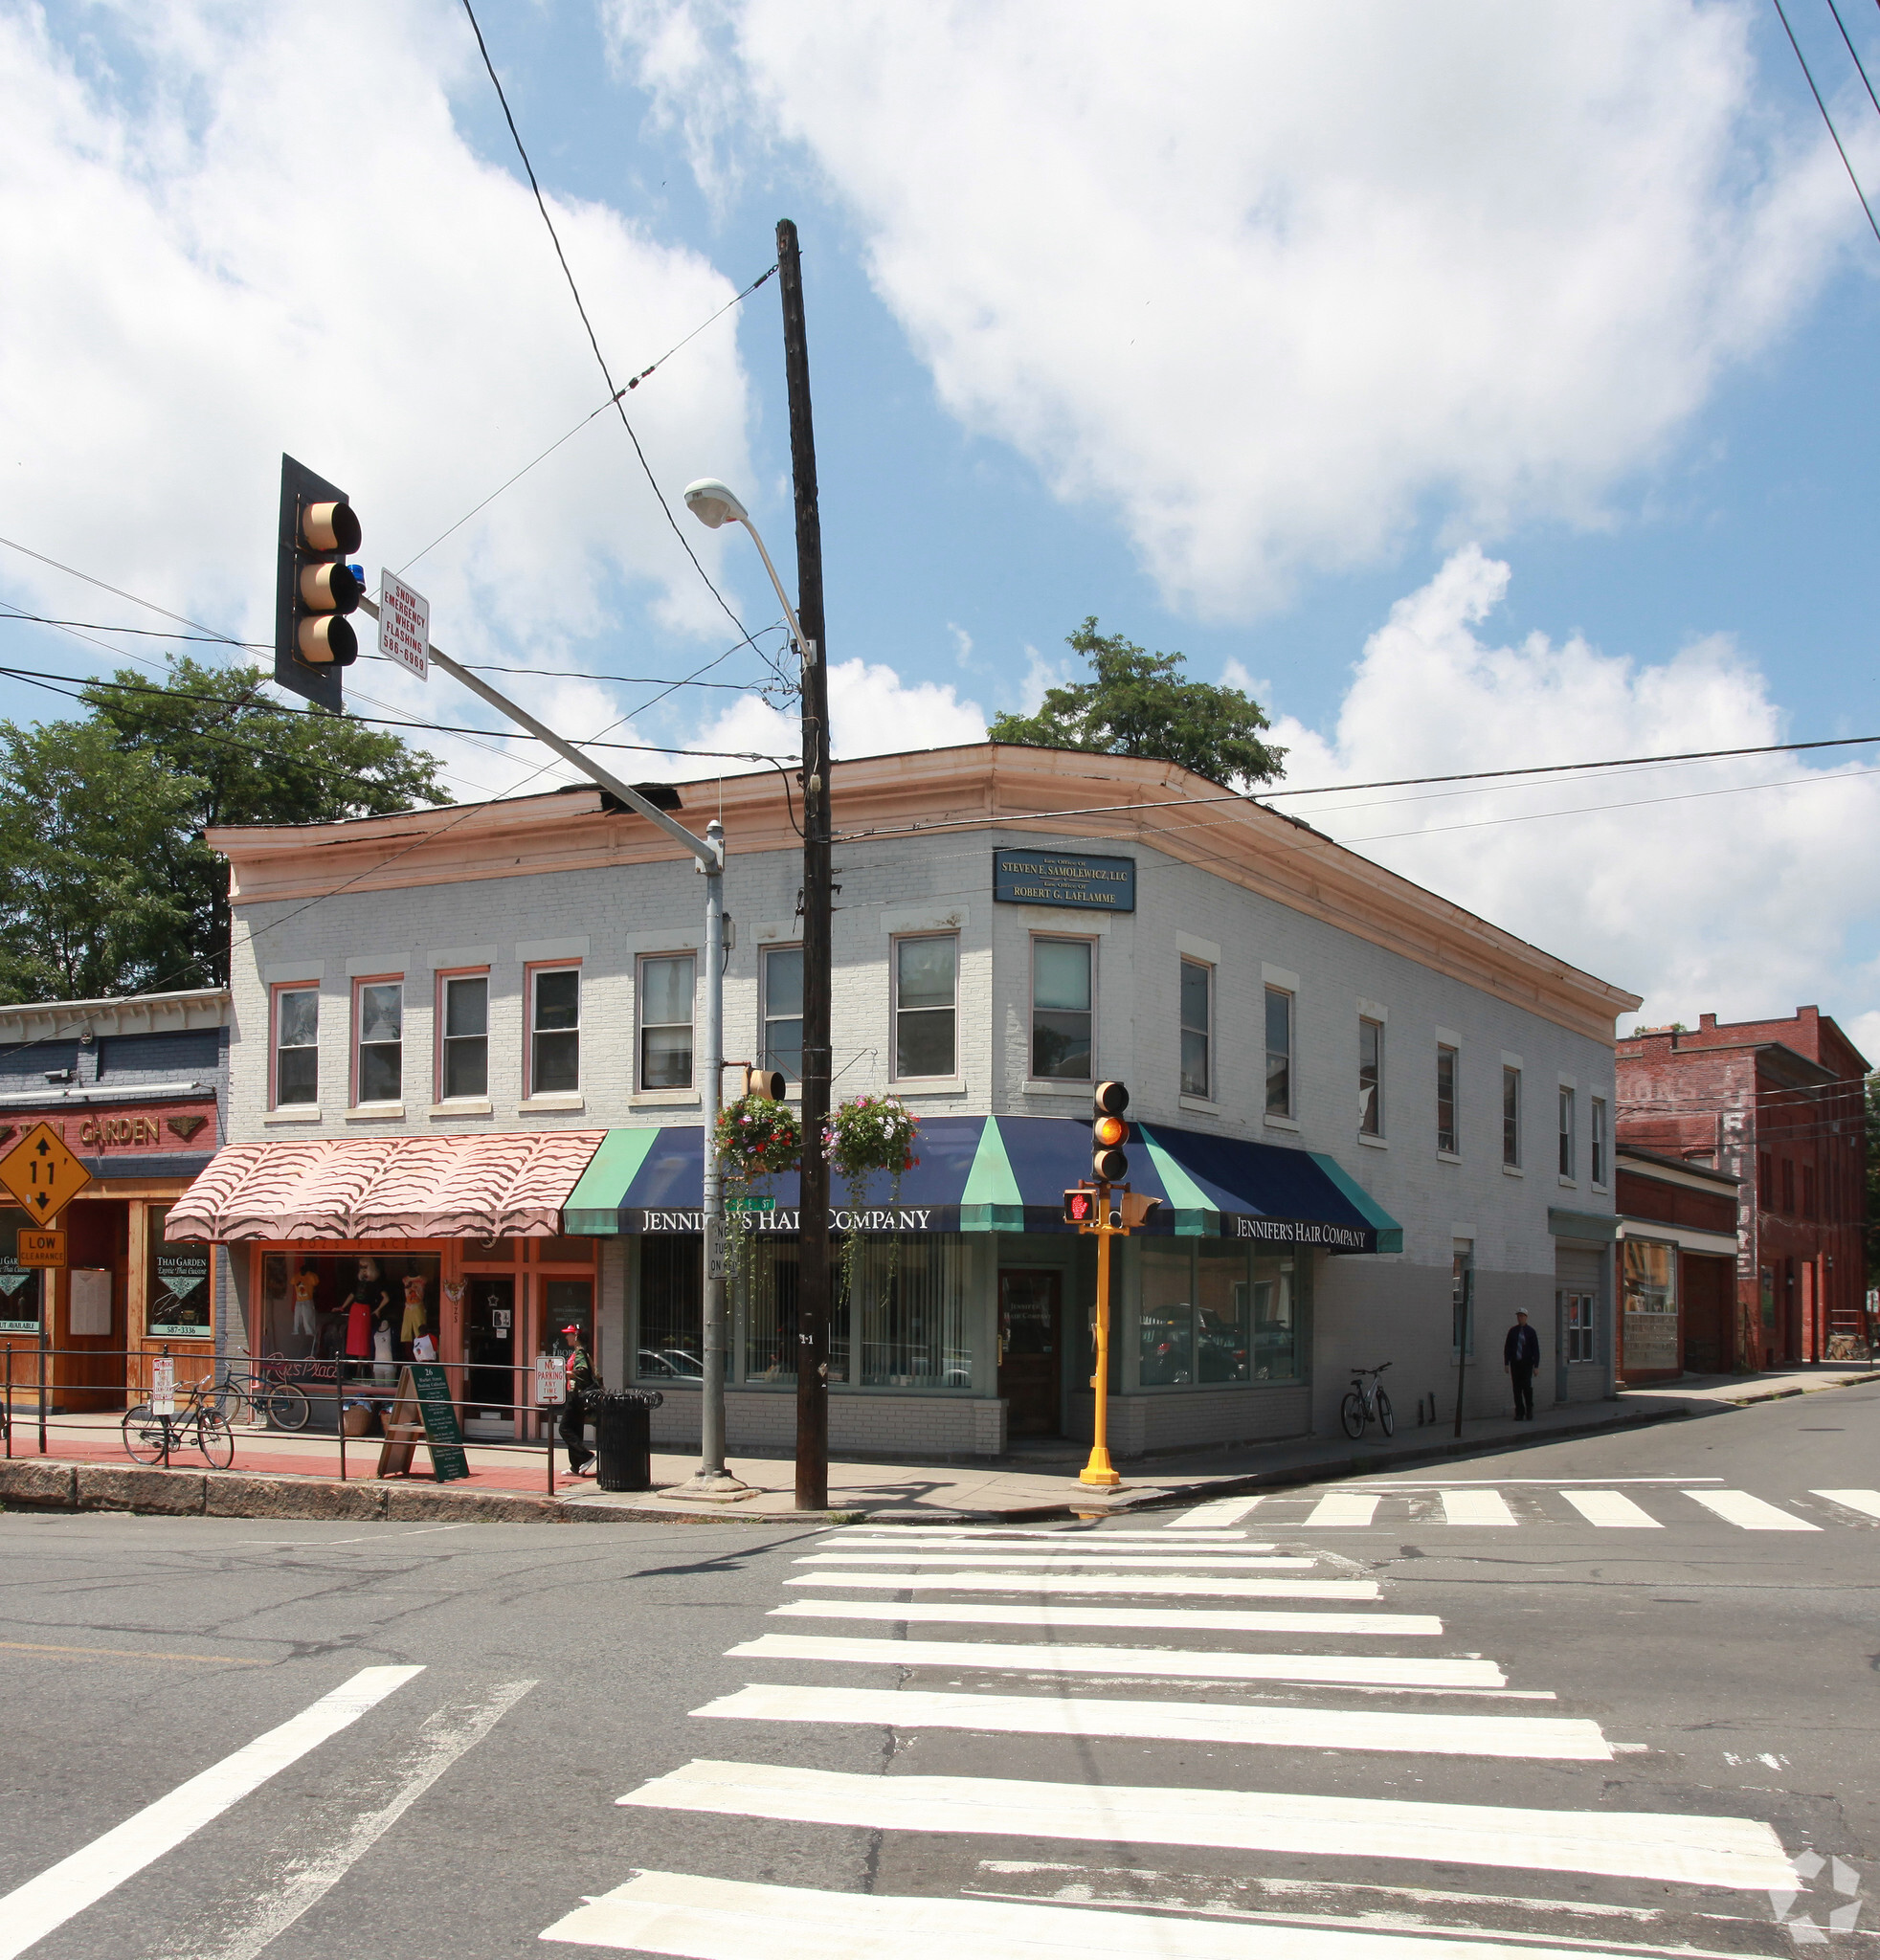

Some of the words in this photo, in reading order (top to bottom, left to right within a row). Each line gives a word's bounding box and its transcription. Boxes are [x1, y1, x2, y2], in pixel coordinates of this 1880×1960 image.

[395, 586, 416, 608] SNOW
[385, 591, 425, 628] EMERGENCY
[395, 612, 415, 635] WHEN
[386, 620, 422, 654] FLASHING
[384, 634, 424, 671] 586-6969
[1001, 862, 1038, 875] STEVEN
[1038, 865, 1047, 875] E.
[1047, 866, 1109, 880] SAMOLEWICZ,
[1110, 871, 1128, 881] LLC
[1014, 886, 1051, 899] ROBERT
[1053, 890, 1063, 900] G.
[1065, 891, 1116, 903] LAFLAMME
[79, 1116, 160, 1142] GARDEN
[758, 1210, 800, 1231] HAI
[1237, 1216, 1293, 1240] JENNIFER'S
[1294, 1222, 1322, 1242] HAIR
[1322, 1224, 1366, 1248] COMPANY
[30, 1236, 56, 1249] LOW
[357, 1237, 409, 1249] PLACE
[21, 1252, 64, 1261] CLEARANCE
[157, 1257, 175, 1266] THAI
[176, 1257, 207, 1266] GARDEN
[167, 1325, 196, 1334] 587-3336
[424, 1368, 434, 1376] 26
[537, 1370, 563, 1380] PARKING
